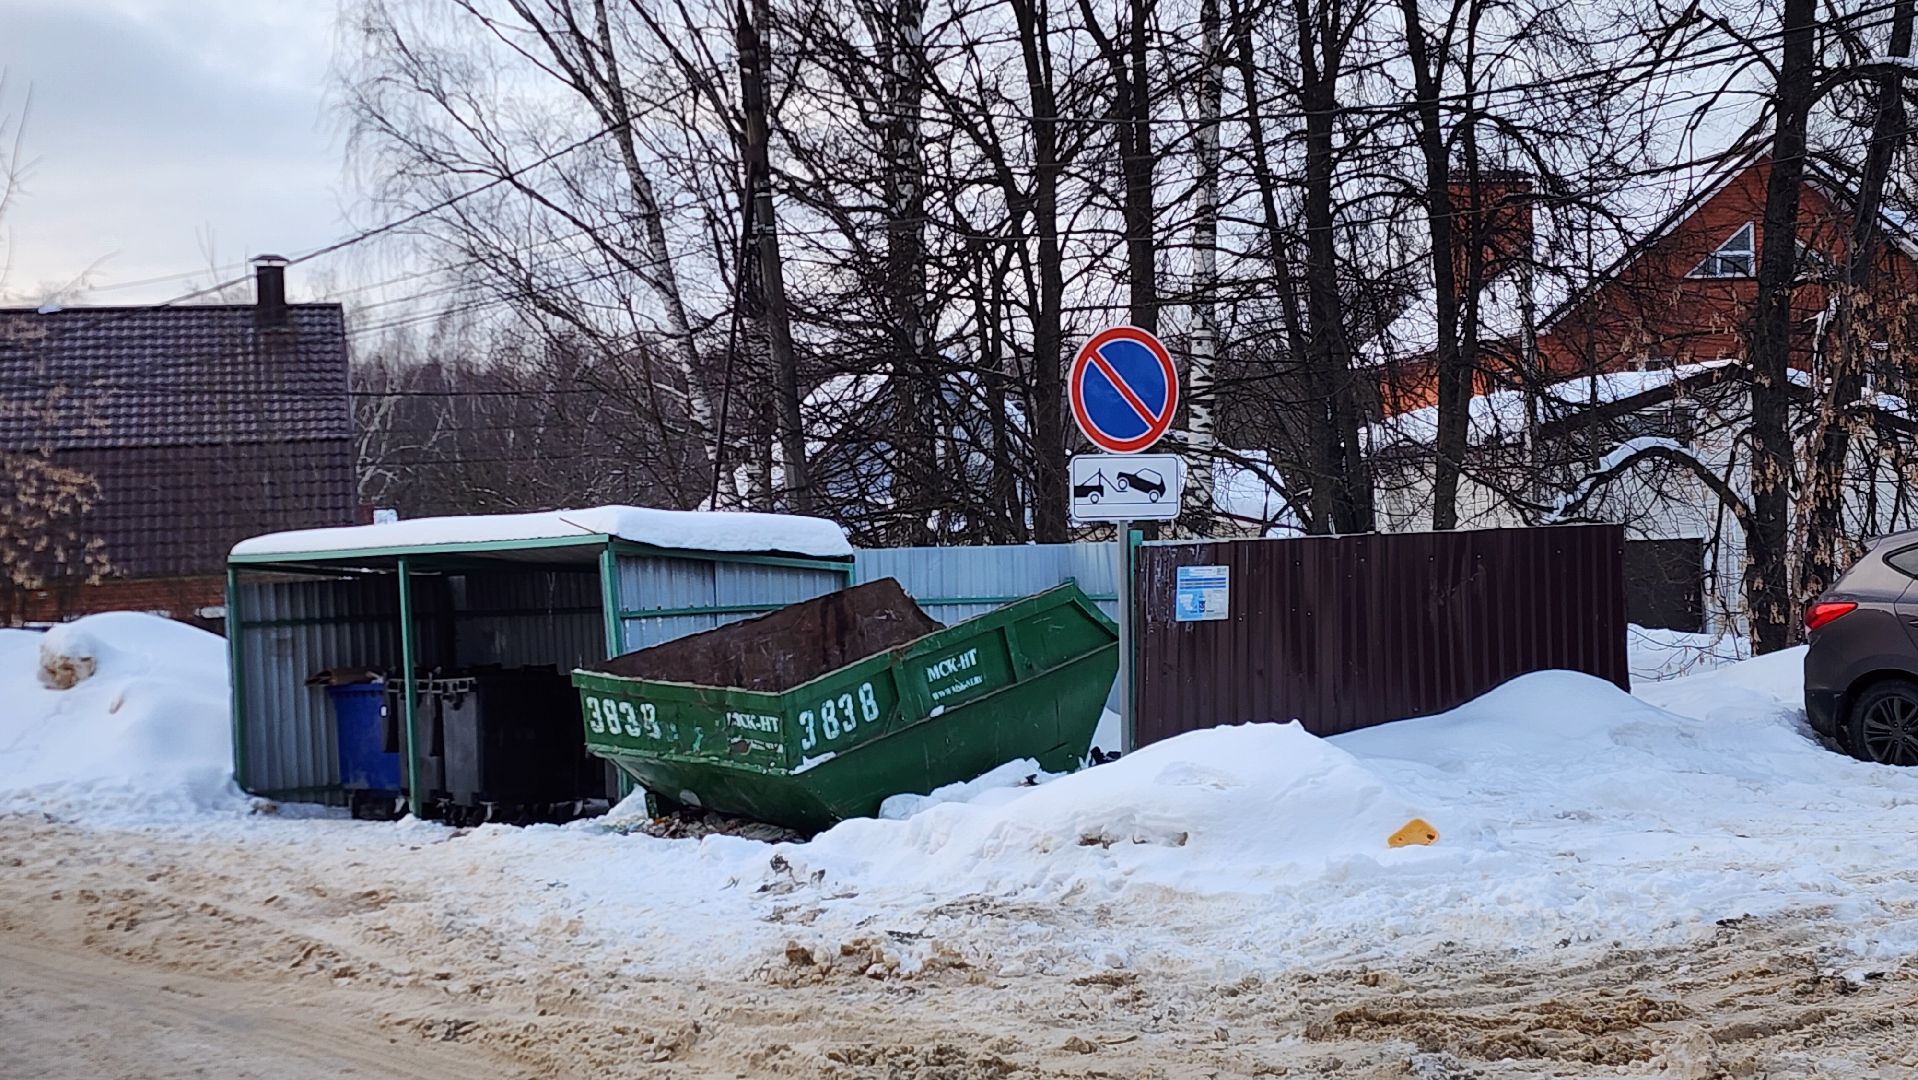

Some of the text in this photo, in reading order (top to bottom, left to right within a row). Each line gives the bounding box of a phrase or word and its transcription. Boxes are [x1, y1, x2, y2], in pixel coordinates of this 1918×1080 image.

[926, 648, 977, 683] МСК-НТ
[586, 696, 662, 740] 3838
[799, 682, 879, 750] 3838
